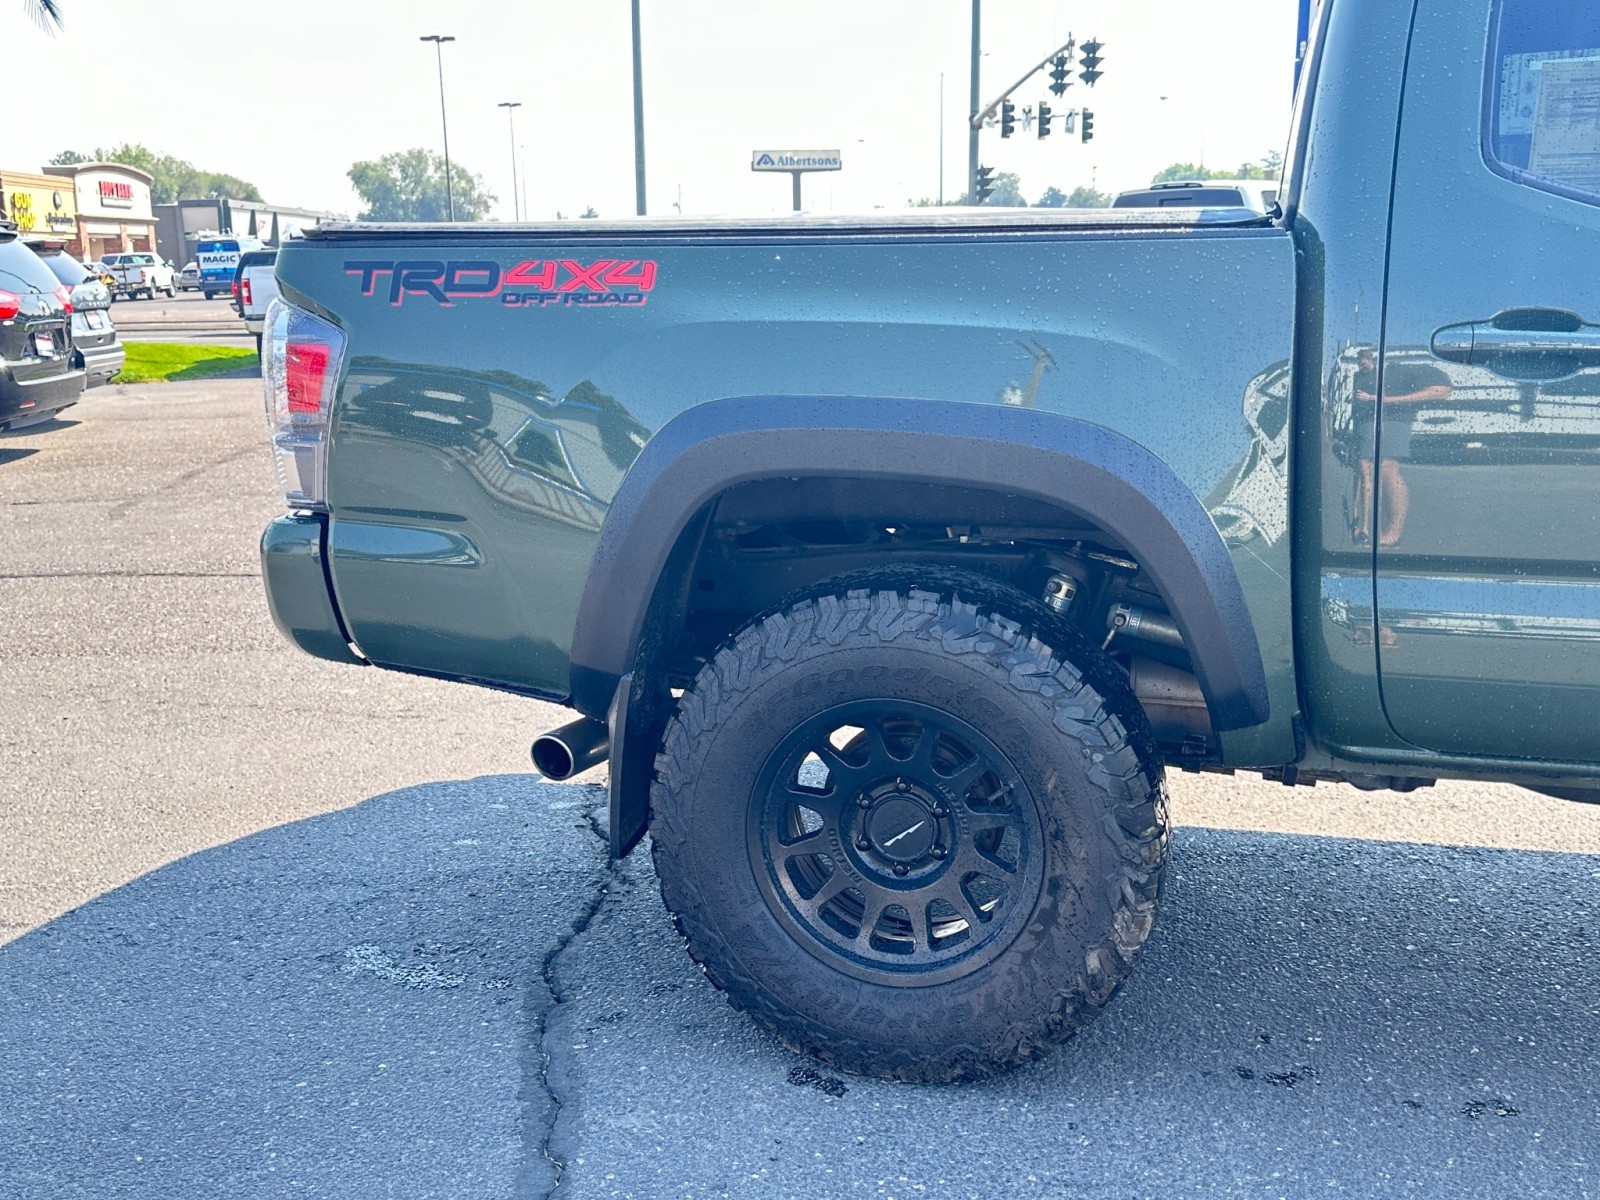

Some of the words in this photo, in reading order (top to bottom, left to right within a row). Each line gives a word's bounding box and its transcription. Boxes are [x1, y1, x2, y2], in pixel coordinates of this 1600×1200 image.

[777, 156, 838, 166] Albertsons
[202, 255, 236, 263] MAGIC
[343, 260, 504, 307] TRD
[503, 259, 657, 292] 4X4
[501, 292, 559, 307] OFF
[563, 292, 649, 307] ROAD
